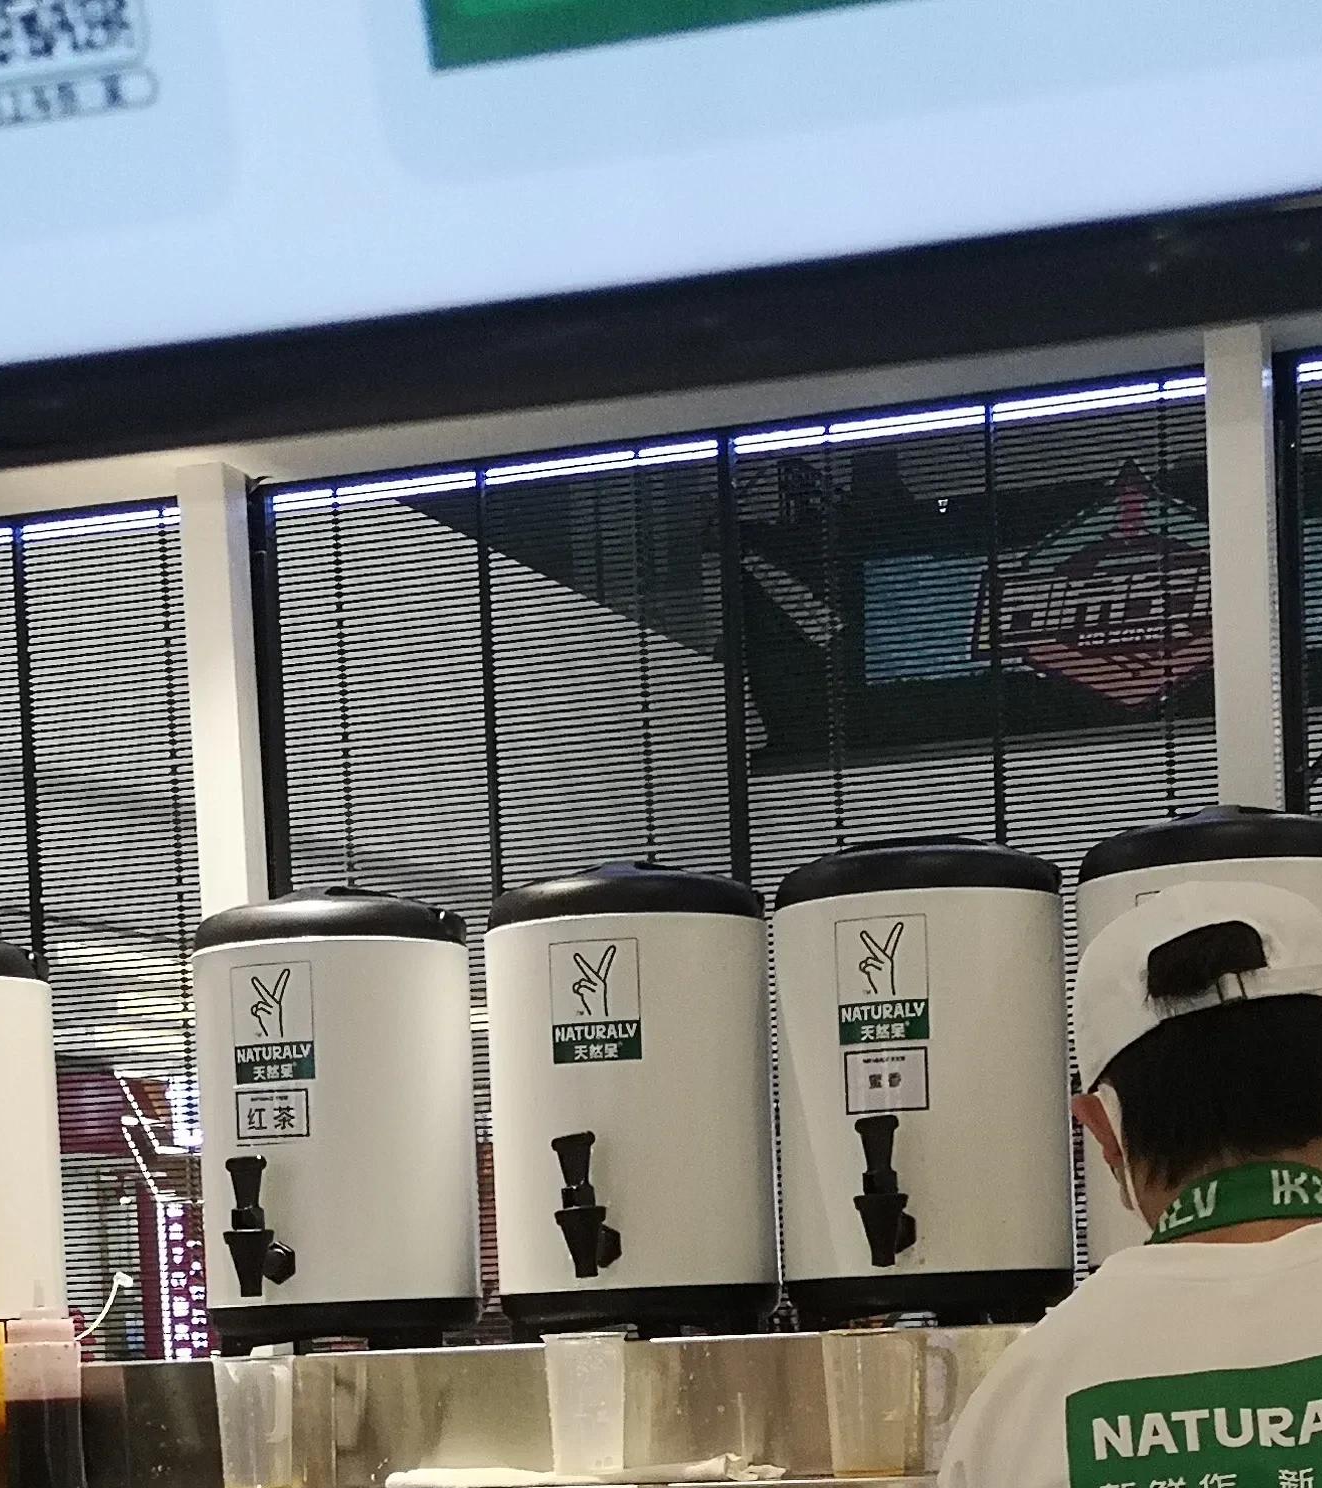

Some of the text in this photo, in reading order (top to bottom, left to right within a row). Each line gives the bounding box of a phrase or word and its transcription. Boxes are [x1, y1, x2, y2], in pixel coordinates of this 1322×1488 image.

[841, 1001, 925, 1023] NATURALV
[555, 1022, 638, 1043] NATURALV
[237, 1043, 312, 1064] NATURALV
[574, 1042, 619, 1061] 天然呆
[247, 1106, 295, 1130] 红茶
